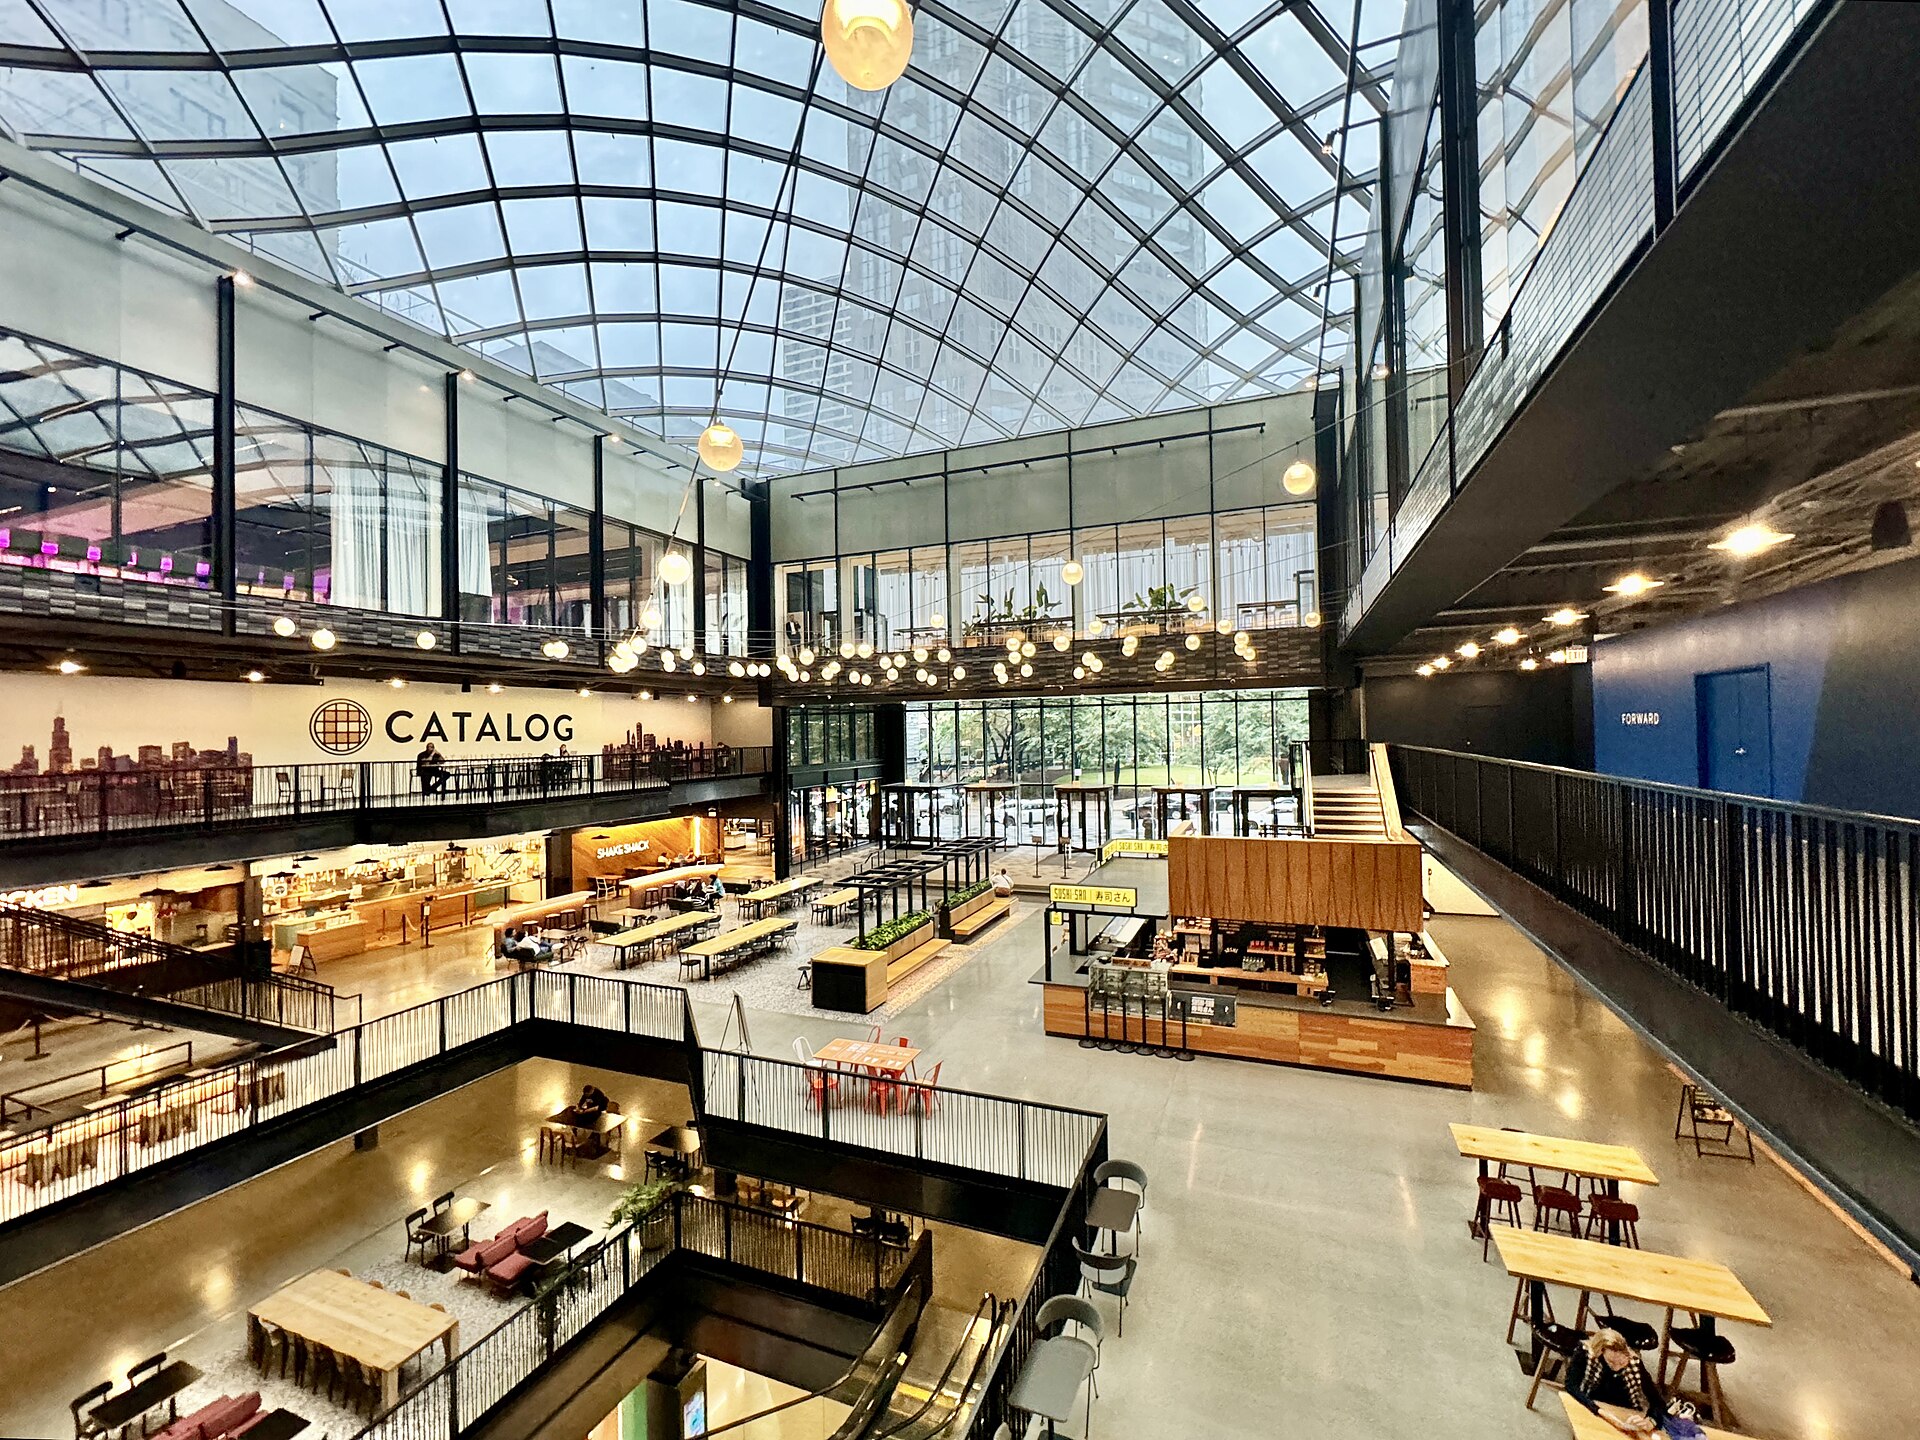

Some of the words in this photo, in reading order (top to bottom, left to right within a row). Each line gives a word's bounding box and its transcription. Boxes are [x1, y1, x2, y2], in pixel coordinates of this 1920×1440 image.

[385, 710, 573, 743] CATALOG
[1621, 712, 1660, 725] FORWARD
[597, 844, 624, 859] SHAKE
[624, 840, 650, 854] SHACK
